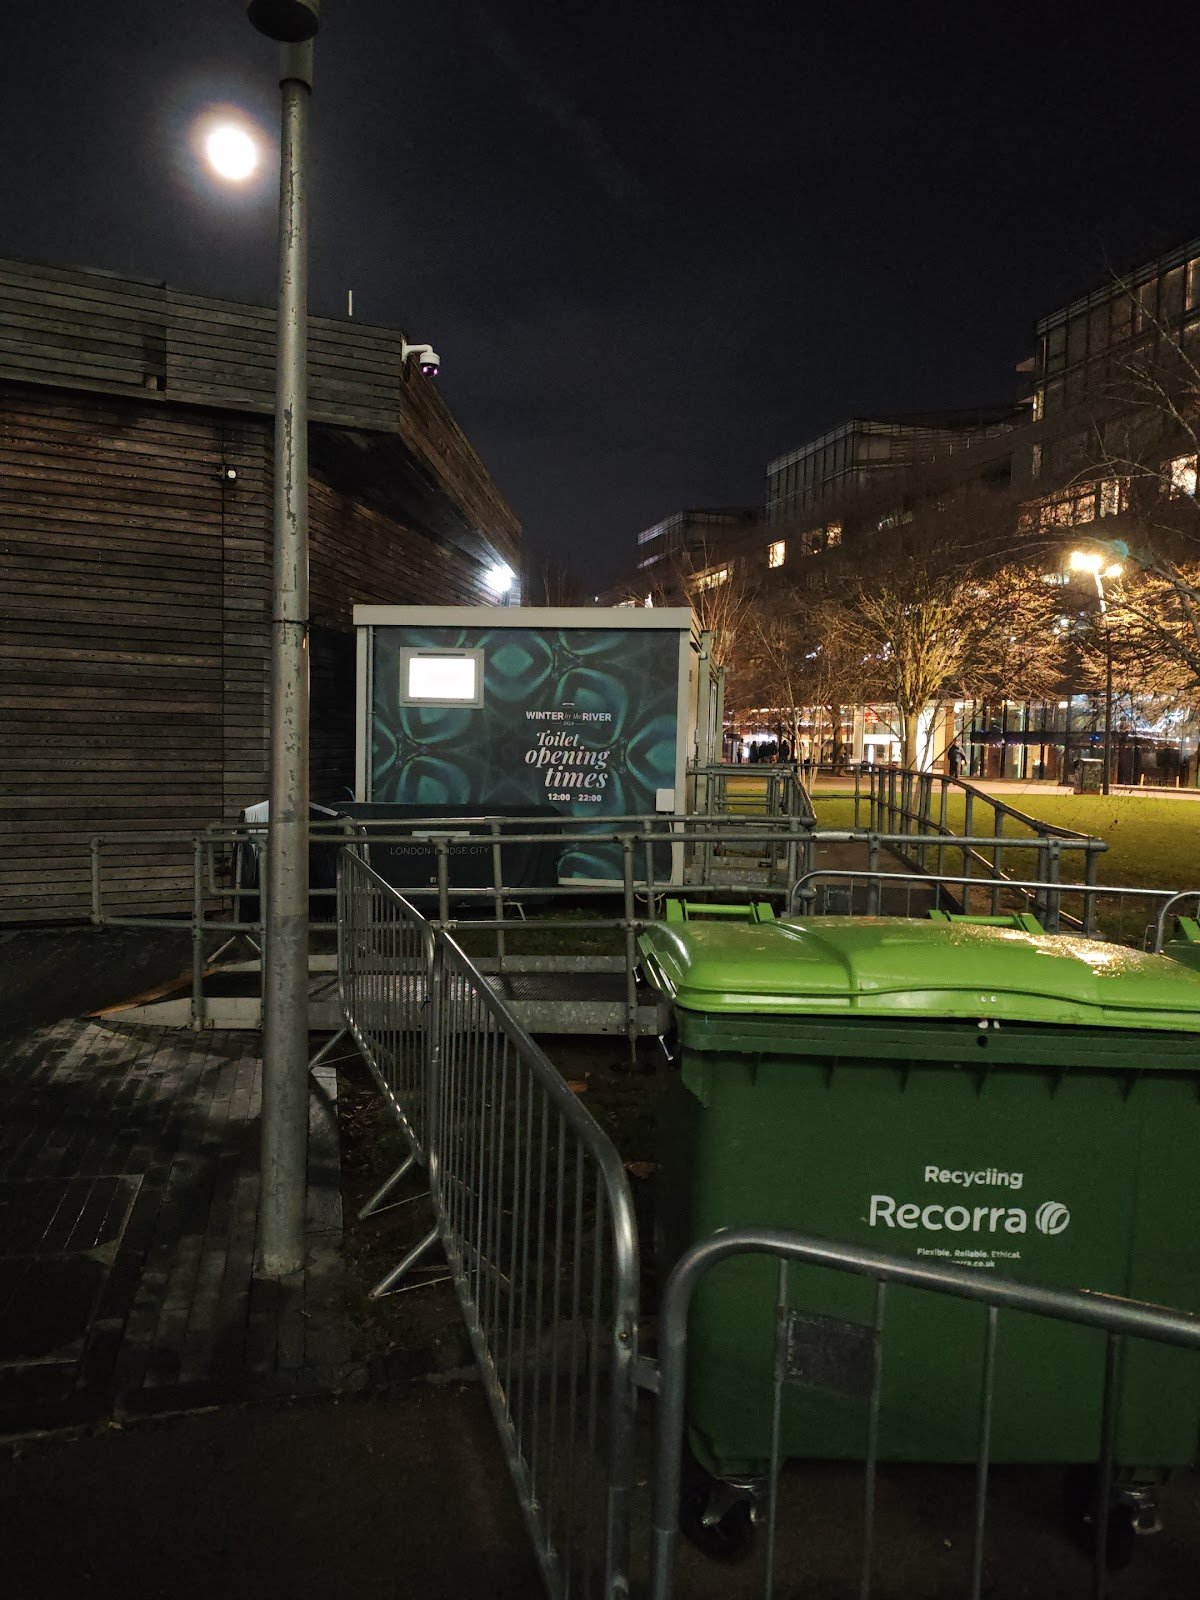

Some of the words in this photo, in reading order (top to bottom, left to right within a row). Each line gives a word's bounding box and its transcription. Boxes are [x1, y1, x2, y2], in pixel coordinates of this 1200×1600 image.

[526, 711, 564, 721] WINTER
[583, 712, 612, 722] RIVER
[536, 730, 579, 747] Toilet
[525, 746, 610, 770] opening
[545, 766, 608, 789] times
[548, 793, 571, 801] 12:00
[578, 793, 602, 802] 22:00
[390, 847, 431, 856] LONDON
[435, 847, 467, 855] BIDGE
[469, 846, 490, 855] CITY
[924, 1165, 1023, 1189] Recycling
[869, 1195, 1027, 1233] Recorra
[917, 1248, 952, 1257] Flexible.
[954, 1249, 989, 1259] Reliable.
[991, 1250, 1021, 1260] Ethical.
